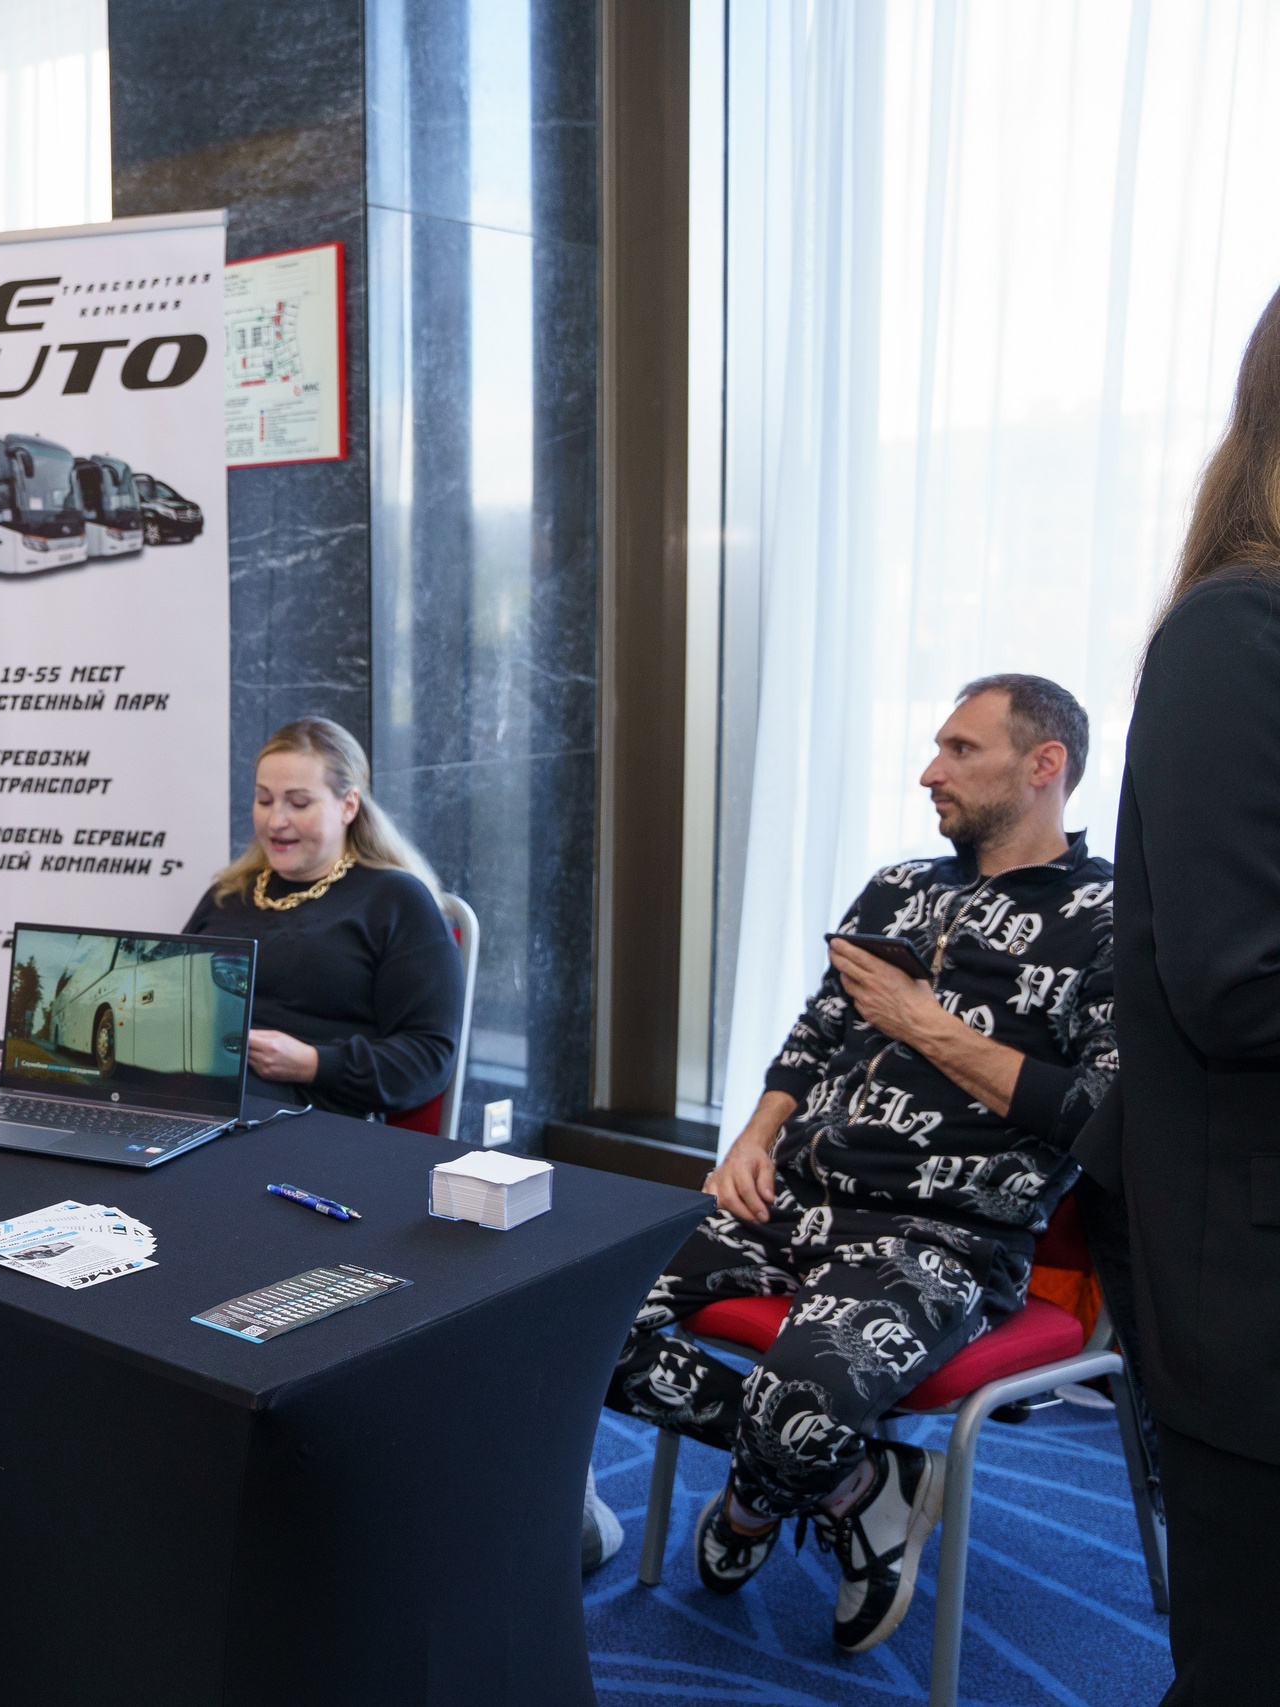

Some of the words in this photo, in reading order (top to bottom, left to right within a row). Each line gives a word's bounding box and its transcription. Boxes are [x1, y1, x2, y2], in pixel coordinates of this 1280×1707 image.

[62, 272, 211, 296] ТРАНСПОРТНАЯ
[79, 299, 182, 318] КОМПАНИЯ
[0, 666, 62, 683] 19-55
[70, 665, 126, 683] МЕСТ
[114, 693, 171, 711] ПАРК
[73, 828, 167, 848] СЕРВИСА
[40, 854, 153, 875] КОМПАНИИ
